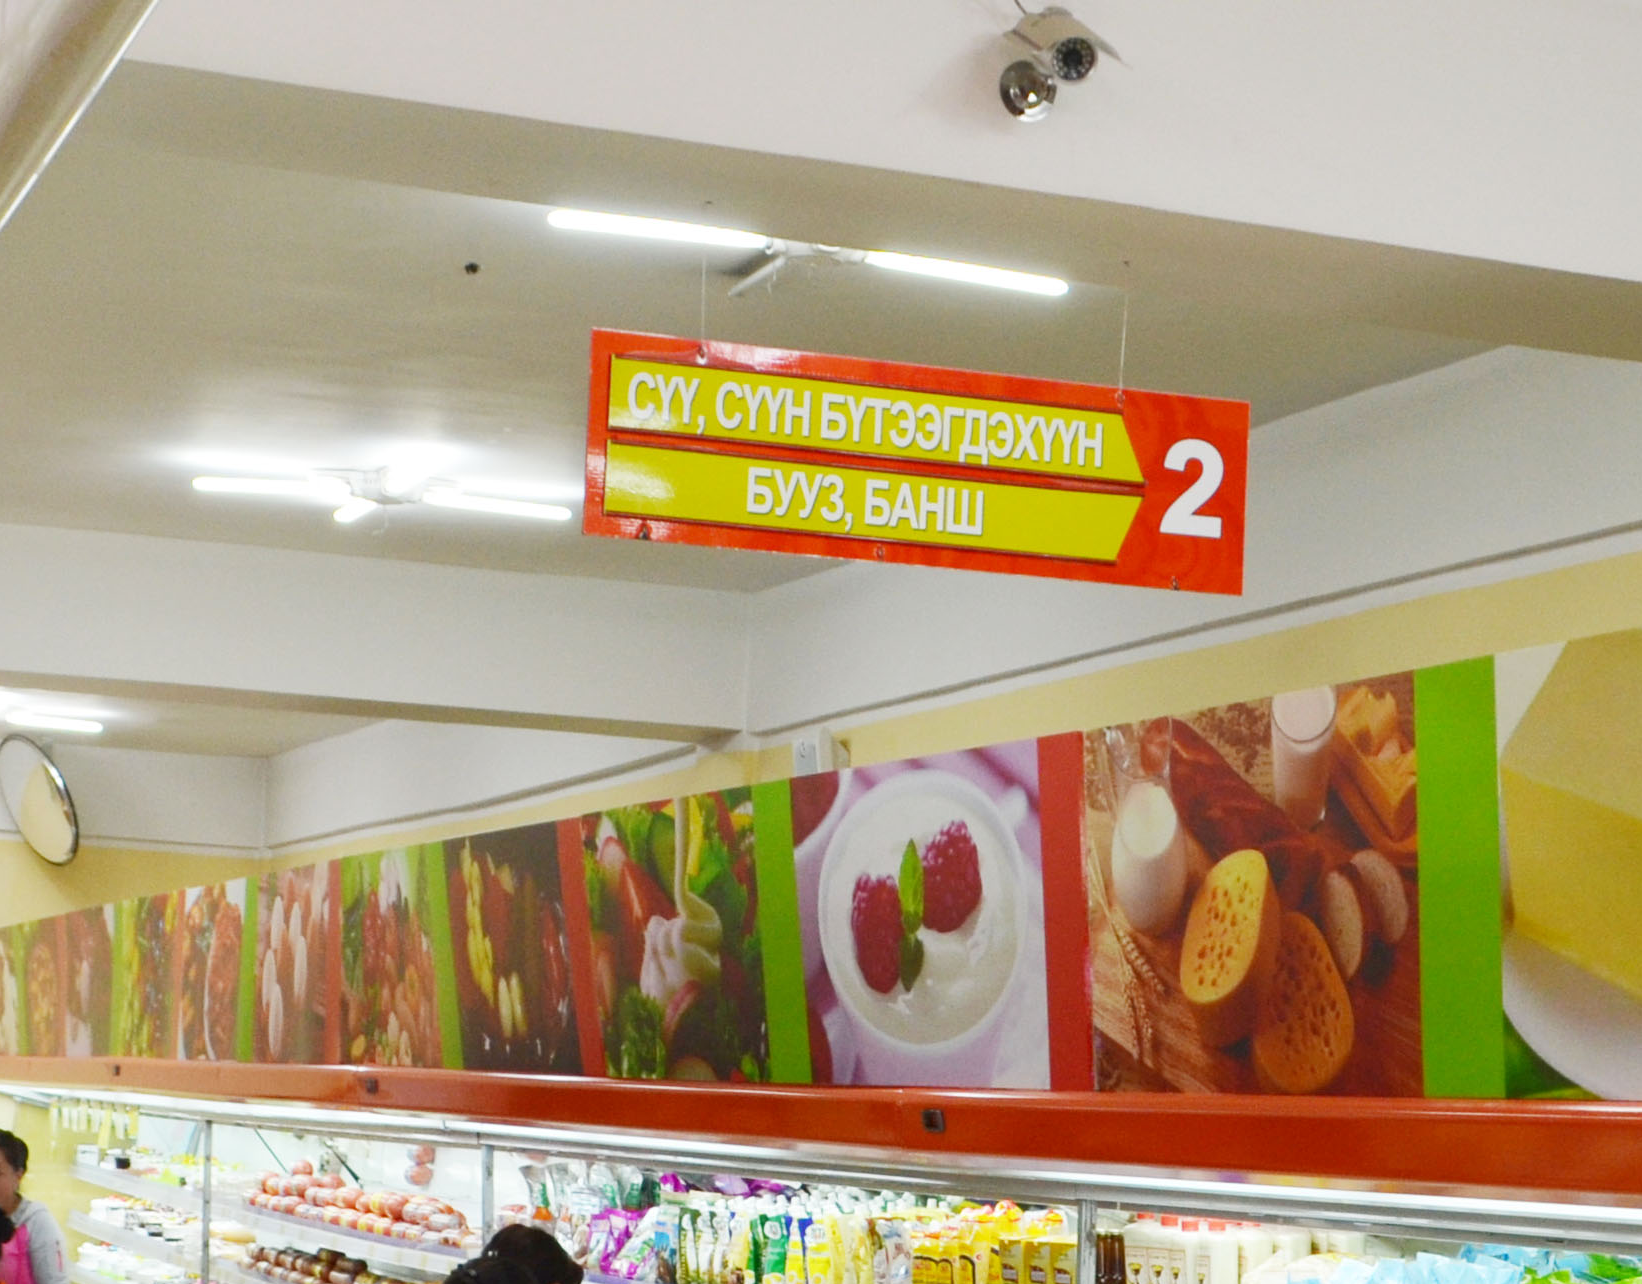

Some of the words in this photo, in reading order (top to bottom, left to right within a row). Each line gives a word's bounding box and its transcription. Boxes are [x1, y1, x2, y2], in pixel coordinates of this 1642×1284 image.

[627, 371, 704, 436] СҮҮ,
[715, 380, 813, 437] СҮҮН
[820, 392, 1105, 468] БҮТЭЭГДЭХҮҮН
[746, 466, 854, 532] БУУЗ,
[863, 480, 986, 538] БАНШ
[1159, 437, 1225, 540] 2
